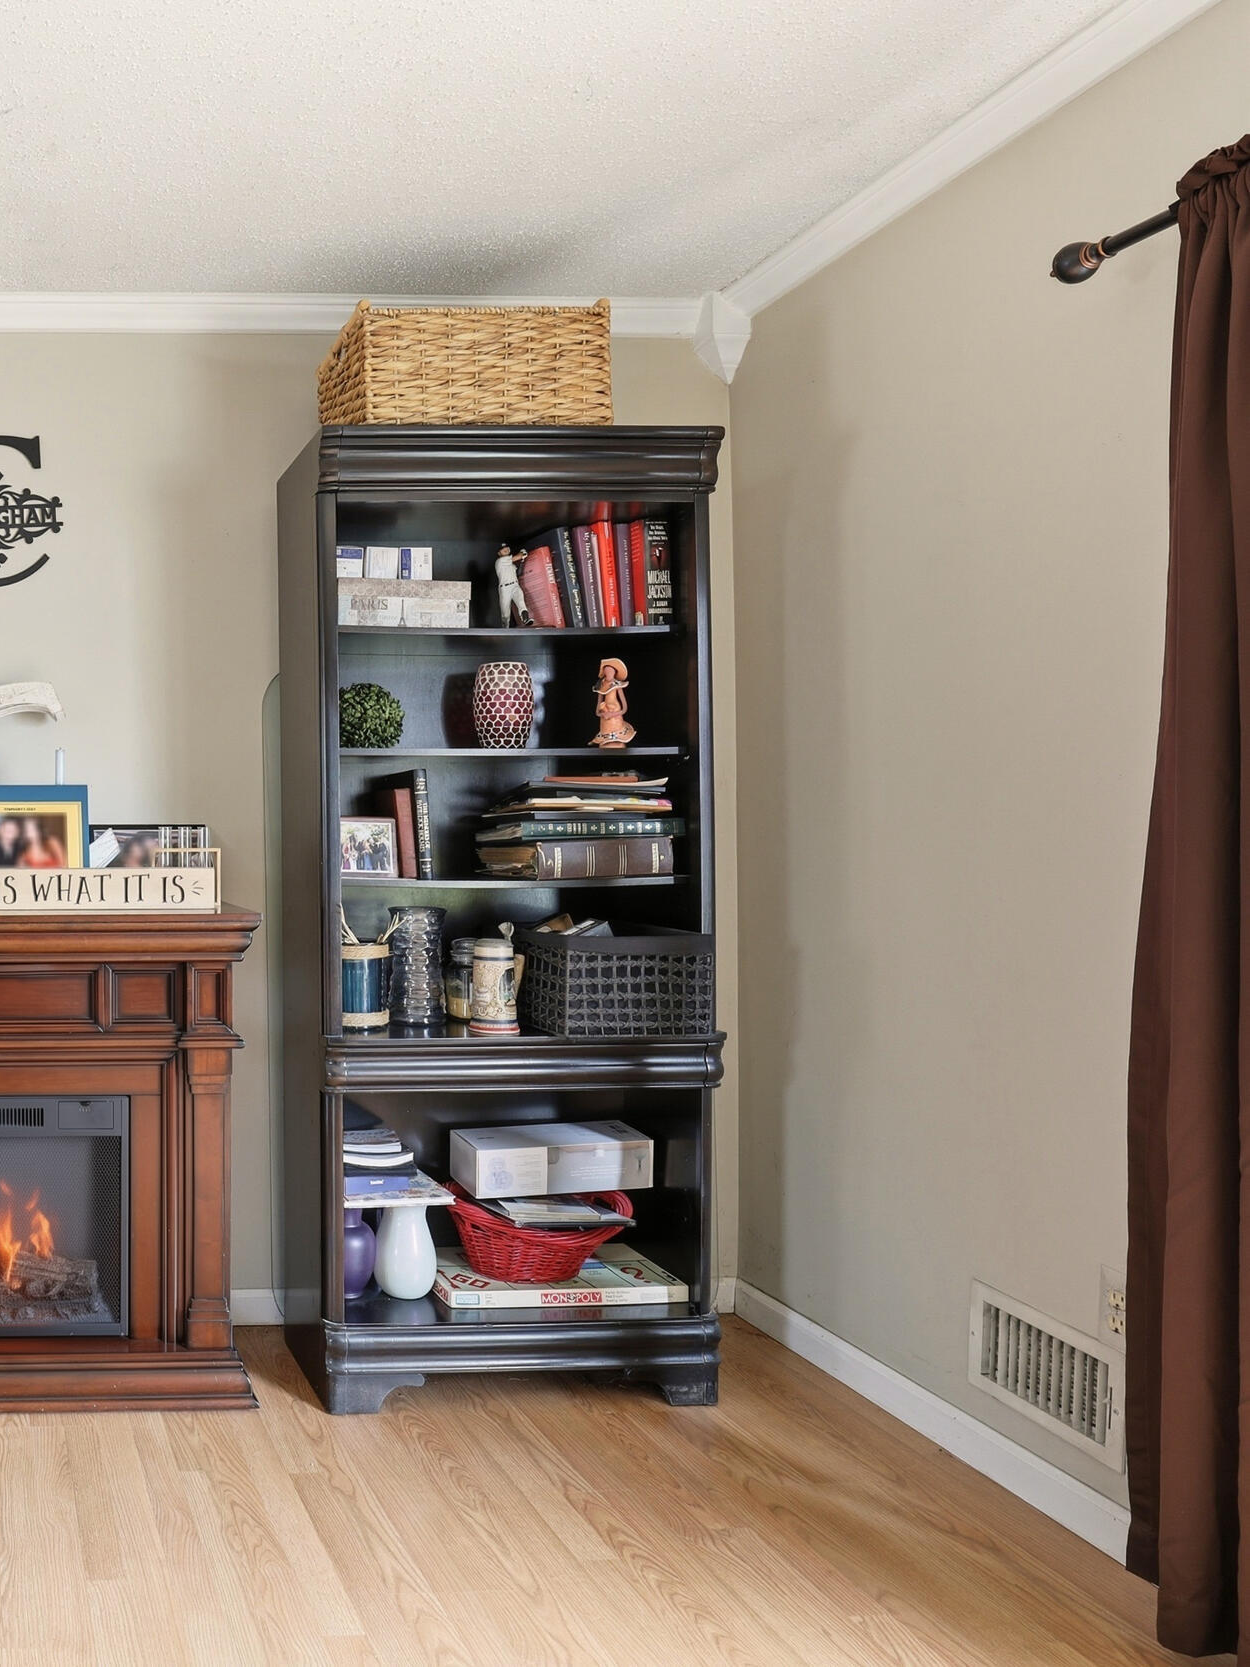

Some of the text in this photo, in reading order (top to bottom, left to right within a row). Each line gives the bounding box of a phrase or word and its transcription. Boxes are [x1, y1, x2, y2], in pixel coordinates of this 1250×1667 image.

[647, 570, 671, 584] MICHAEL
[647, 585, 672, 599] JACKSON
[350, 599, 388, 610] PARIS
[30, 874, 111, 905] WHAT
[123, 874, 151, 904] IT
[161, 875, 185, 905] IS
[451, 1273, 490, 1288] GO
[541, 1292, 602, 1304] MONOPOLY
